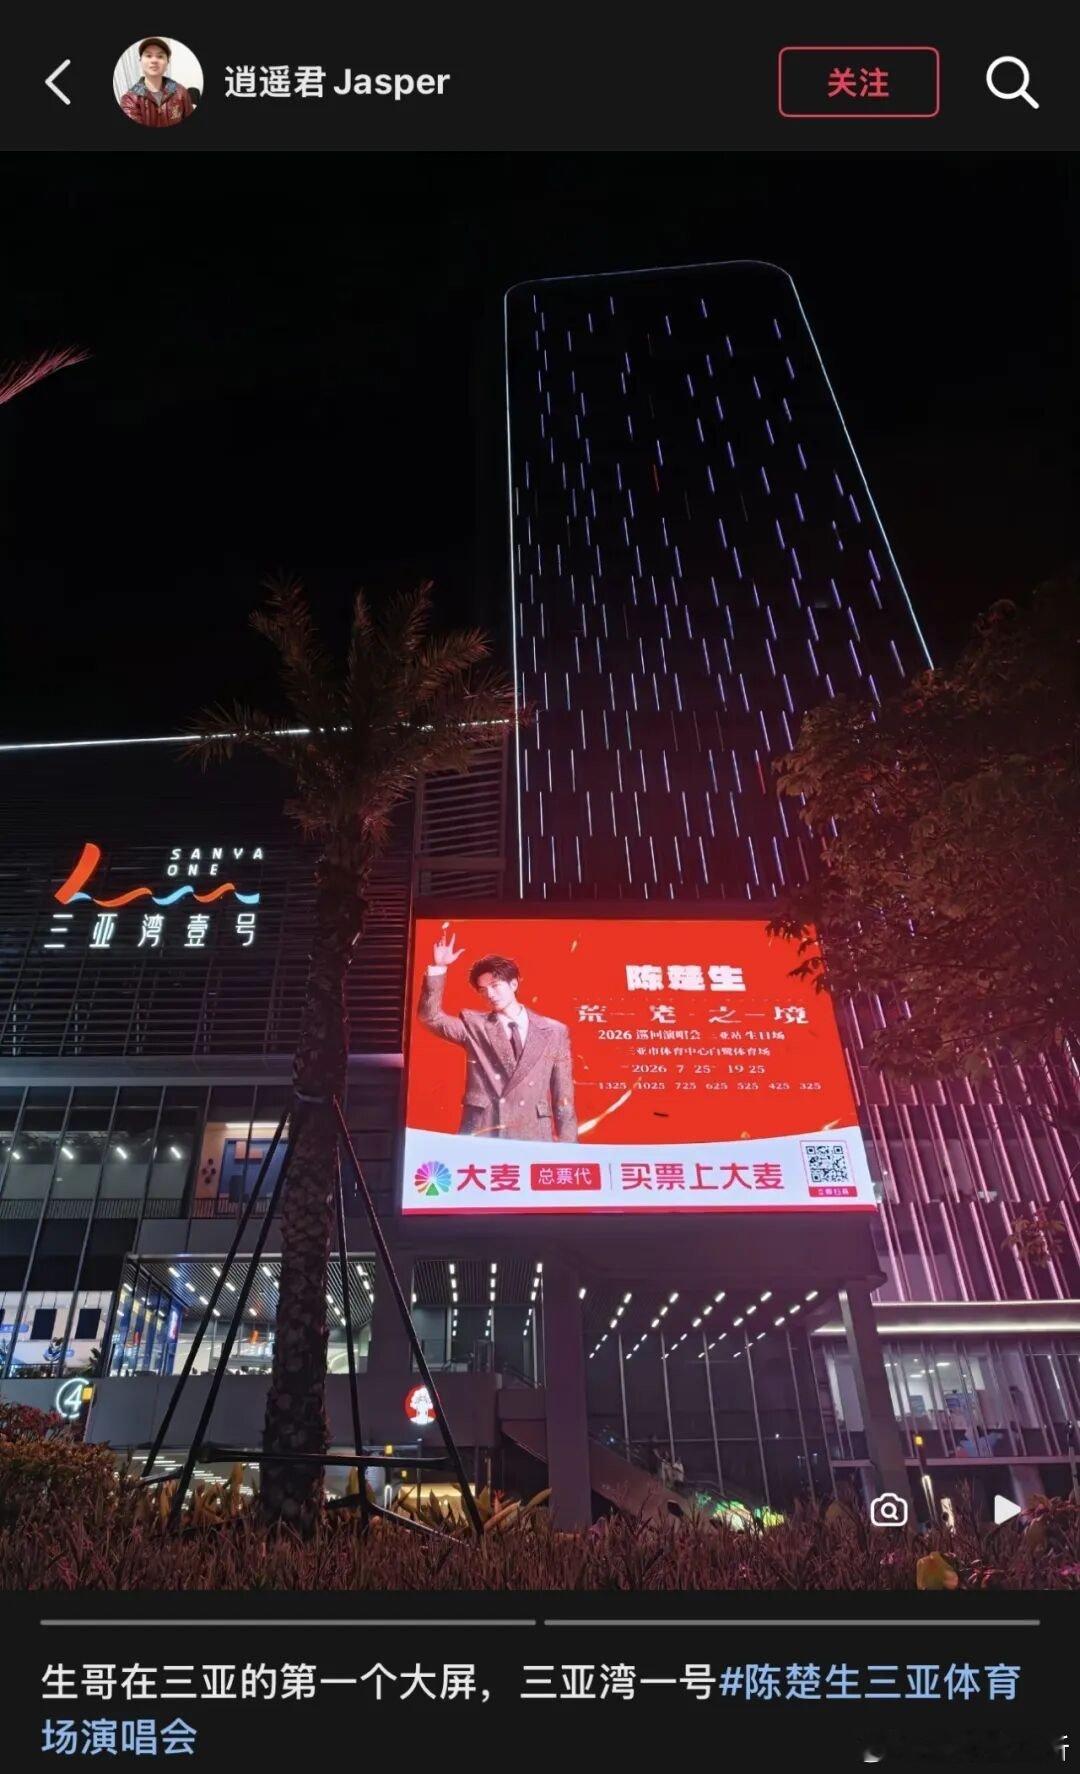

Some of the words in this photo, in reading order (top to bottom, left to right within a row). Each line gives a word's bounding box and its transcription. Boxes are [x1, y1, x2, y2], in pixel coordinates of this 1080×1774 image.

[170, 847, 263, 861] SANYA
[167, 863, 219, 877] ONE
[44, 913, 257, 948] 三亚湾壹号
[625, 964, 746, 992] 陈楚生
[598, 1029, 632, 1041] 2026
[457, 1163, 521, 1192] 大麦
[537, 1167, 593, 1186] 总票代
[620, 1162, 785, 1191] 买票上大麦
